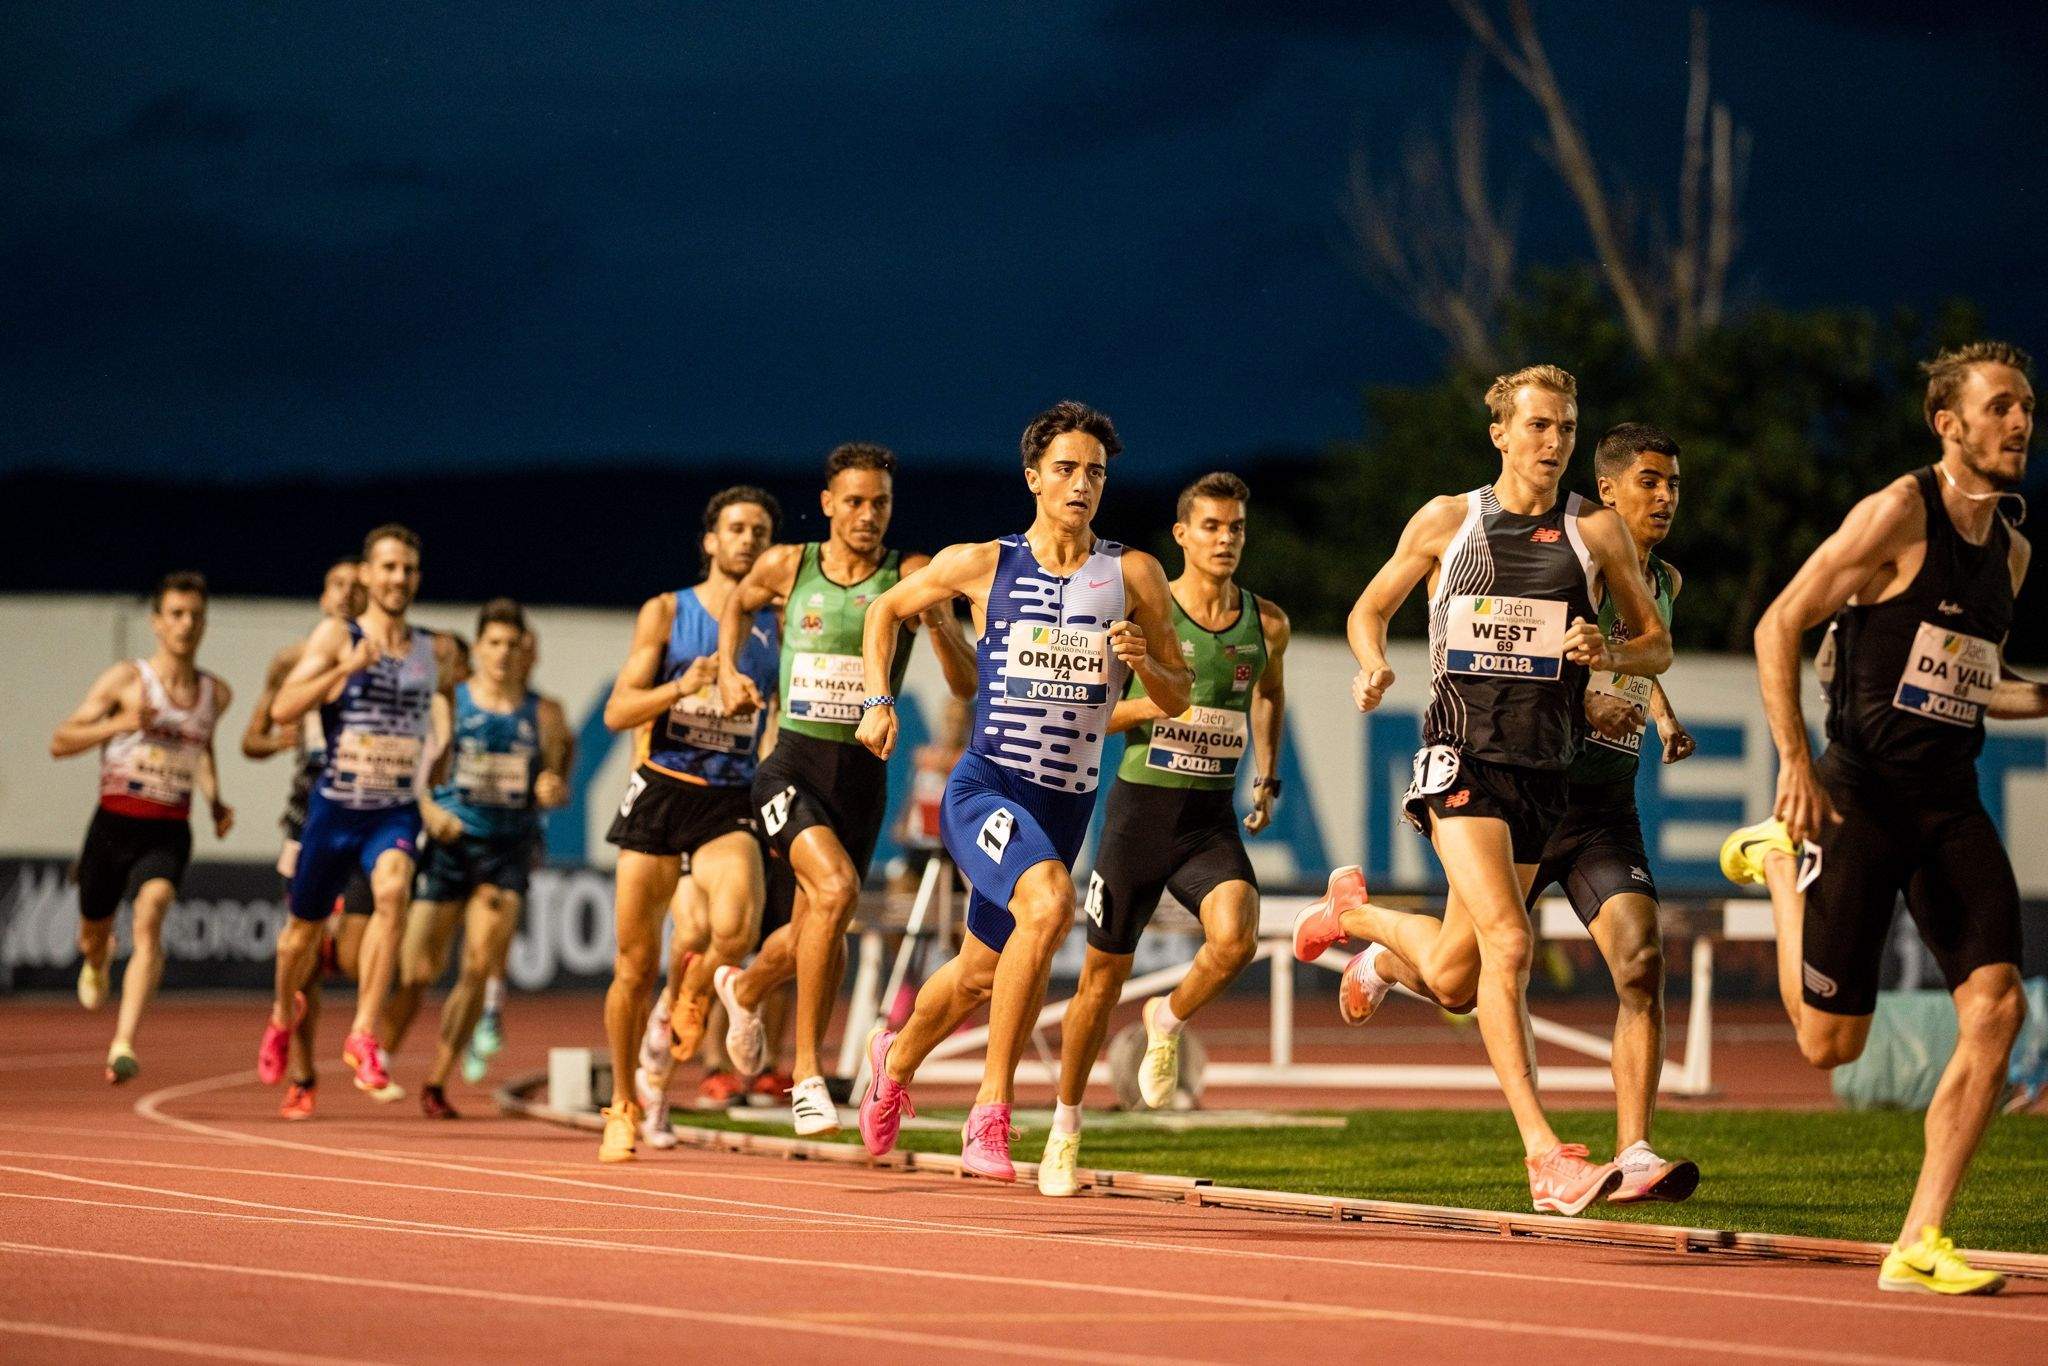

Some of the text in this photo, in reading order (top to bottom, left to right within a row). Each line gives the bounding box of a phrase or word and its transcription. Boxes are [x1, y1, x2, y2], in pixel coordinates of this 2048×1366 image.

[1494, 598, 1533, 618] Jaén
[1051, 628, 1089, 648] Jaén
[1472, 622, 1537, 643] WEST
[1497, 641, 1513, 652] 69
[1018, 650, 1104, 673] ORIACH
[1053, 669, 1071, 681] 74
[793, 677, 865, 693] EL KHAYA
[831, 692, 845, 700] 77
[1154, 726, 1243, 748] PANIAGUA
[1194, 745, 1208, 755] 78
